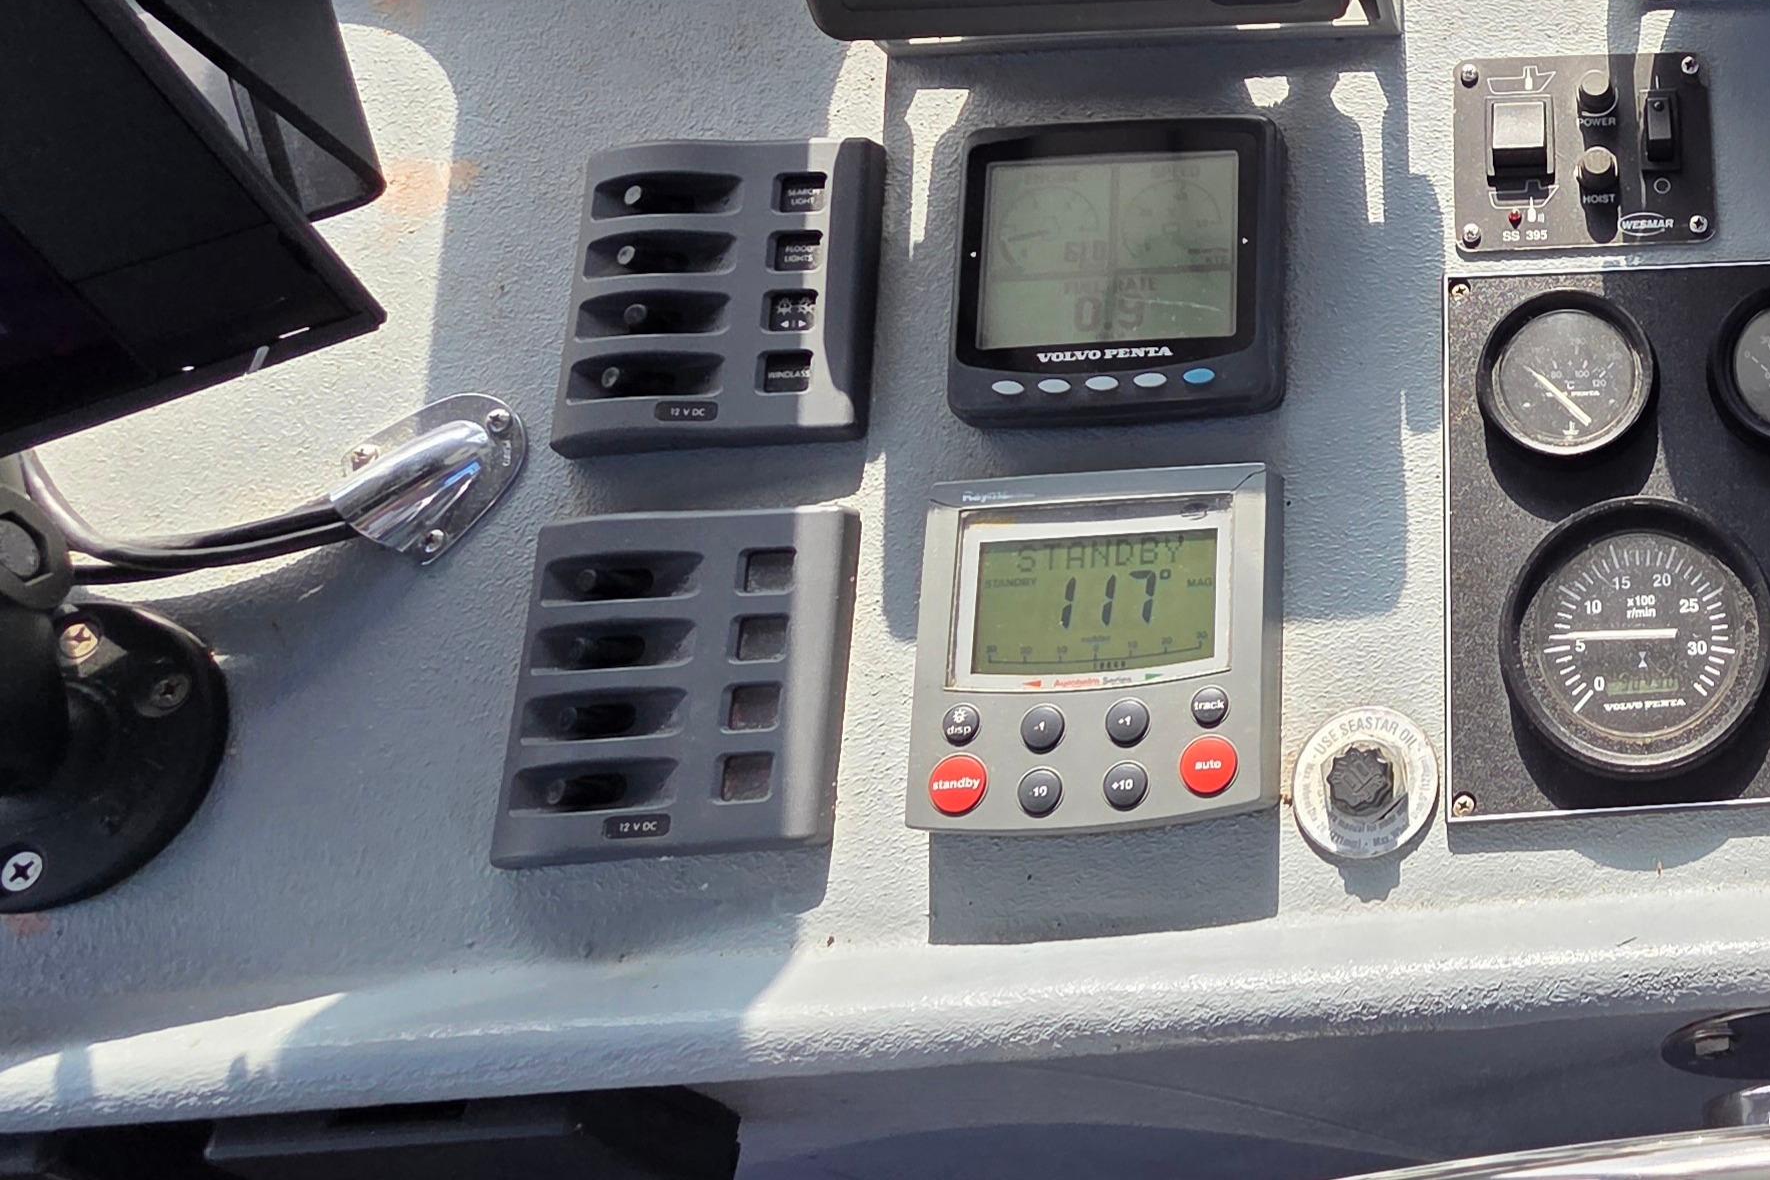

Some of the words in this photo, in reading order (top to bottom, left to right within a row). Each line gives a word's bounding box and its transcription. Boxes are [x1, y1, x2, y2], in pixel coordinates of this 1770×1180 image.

[1576, 117, 1617, 127] POWER
[786, 188, 822, 198] SEARCH
[1582, 193, 1616, 204] HOIST
[790, 196, 815, 206] LIGHT
[1621, 218, 1675, 231] WESMAR
[1502, 230, 1521, 242] SS
[1525, 229, 1548, 241] 395
[784, 245, 814, 254] FLOOD
[783, 253, 814, 263] LIGHTS
[1036, 348, 1101, 364] VOLVO
[1103, 345, 1174, 360] PENTA
[767, 368, 813, 380] WINDLASS
[1574, 370, 1590, 378] 100
[670, 407, 680, 417] 12
[682, 407, 691, 416] V
[691, 407, 705, 417] DC
[1016, 537, 1185, 573] STANDBY
[985, 576, 1038, 589] STANDBY
[1186, 577, 1213, 589] MAG
[1612, 576, 1631, 590] 15
[1652, 573, 1672, 587] 20
[1584, 599, 1602, 614] 10
[1626, 595, 1656, 607] x100
[1679, 598, 1700, 613] 25
[1626, 606, 1656, 618] r/min
[1575, 639, 1586, 652] 5
[1687, 641, 1708, 655] 30
[1593, 677, 1605, 691] 0
[1194, 698, 1226, 710] track
[1603, 701, 1643, 712] VOLVO
[1644, 698, 1687, 710] PENTA
[1033, 720, 1045, 731] -1
[1117, 715, 1132, 727] +1
[946, 724, 972, 735] disp
[1313, 730, 1340, 755] USE
[1339, 715, 1400, 737] SEASTAR
[1399, 729, 1419, 750] OIL
[1194, 759, 1222, 771] auto
[931, 776, 980, 791] standby
[1111, 779, 1134, 791] +10
[1029, 786, 1047, 798] -10
[619, 822, 630, 832] 12
[632, 821, 641, 831] V
[641, 820, 658, 831] DC
